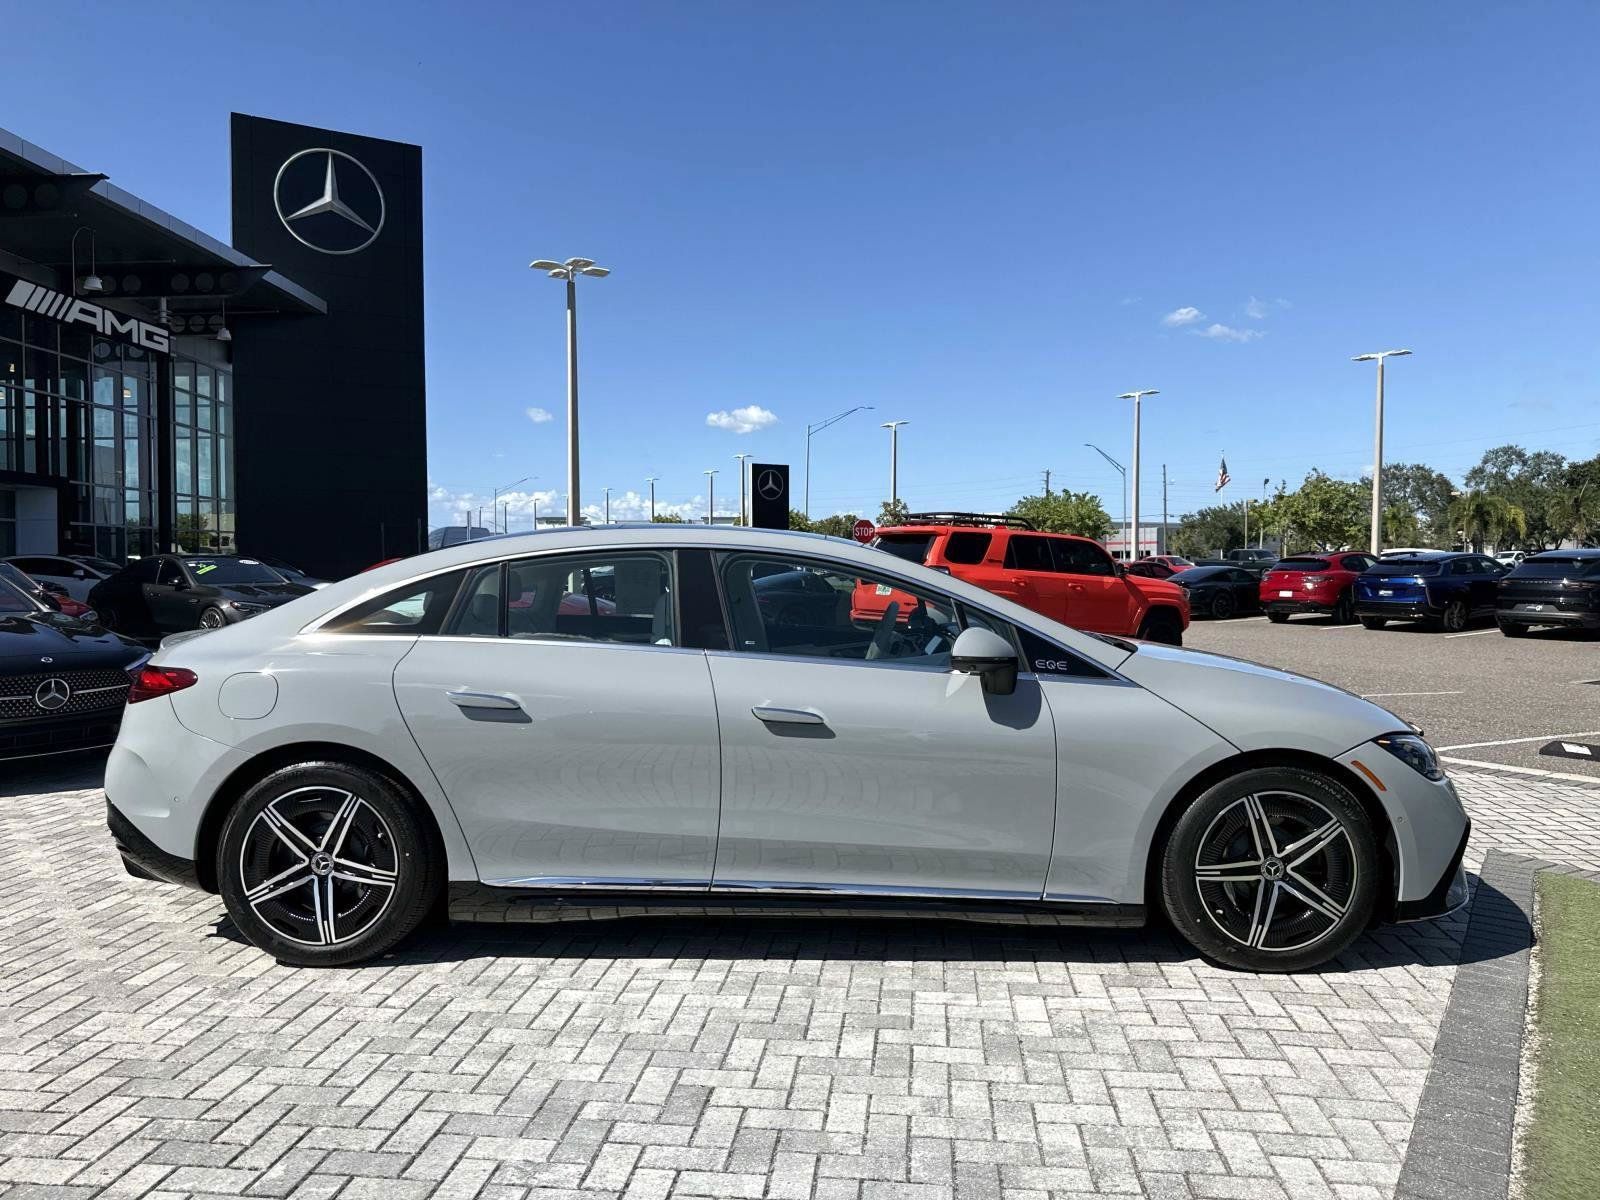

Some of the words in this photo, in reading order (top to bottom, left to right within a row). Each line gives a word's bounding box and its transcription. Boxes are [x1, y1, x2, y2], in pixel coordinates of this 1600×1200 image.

[64, 298, 169, 354] AMG
[855, 527, 874, 537] STOP
[1035, 659, 1067, 671] EQE
